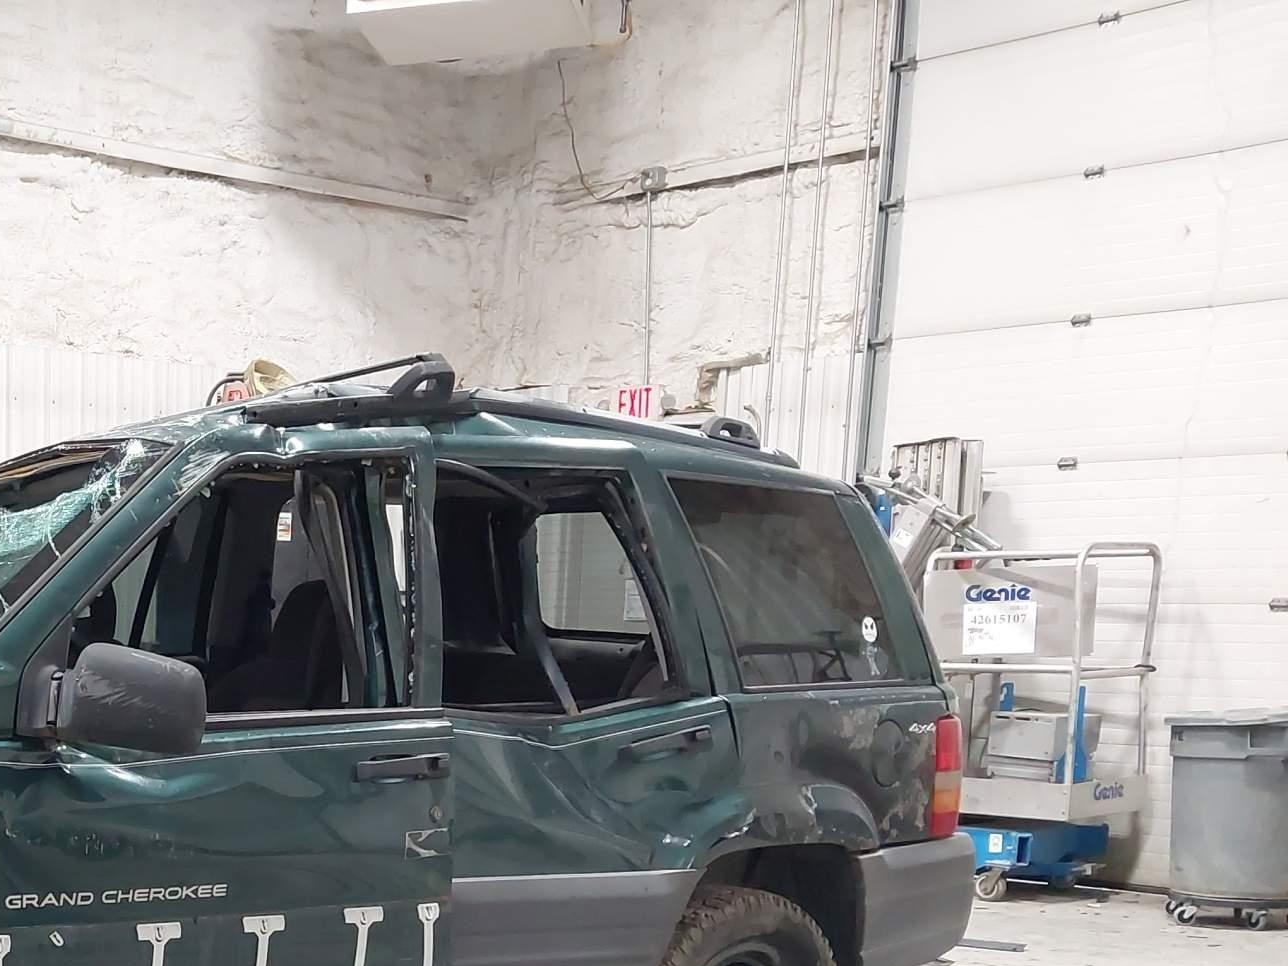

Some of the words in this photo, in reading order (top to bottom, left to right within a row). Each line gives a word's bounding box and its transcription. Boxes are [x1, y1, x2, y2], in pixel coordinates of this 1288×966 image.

[618, 387, 652, 418] EXIT
[965, 583, 1031, 602] Genie
[1093, 781, 1124, 801] Genie
[5, 892, 94, 909] GRAND
[101, 884, 228, 904] CHEROKEE
